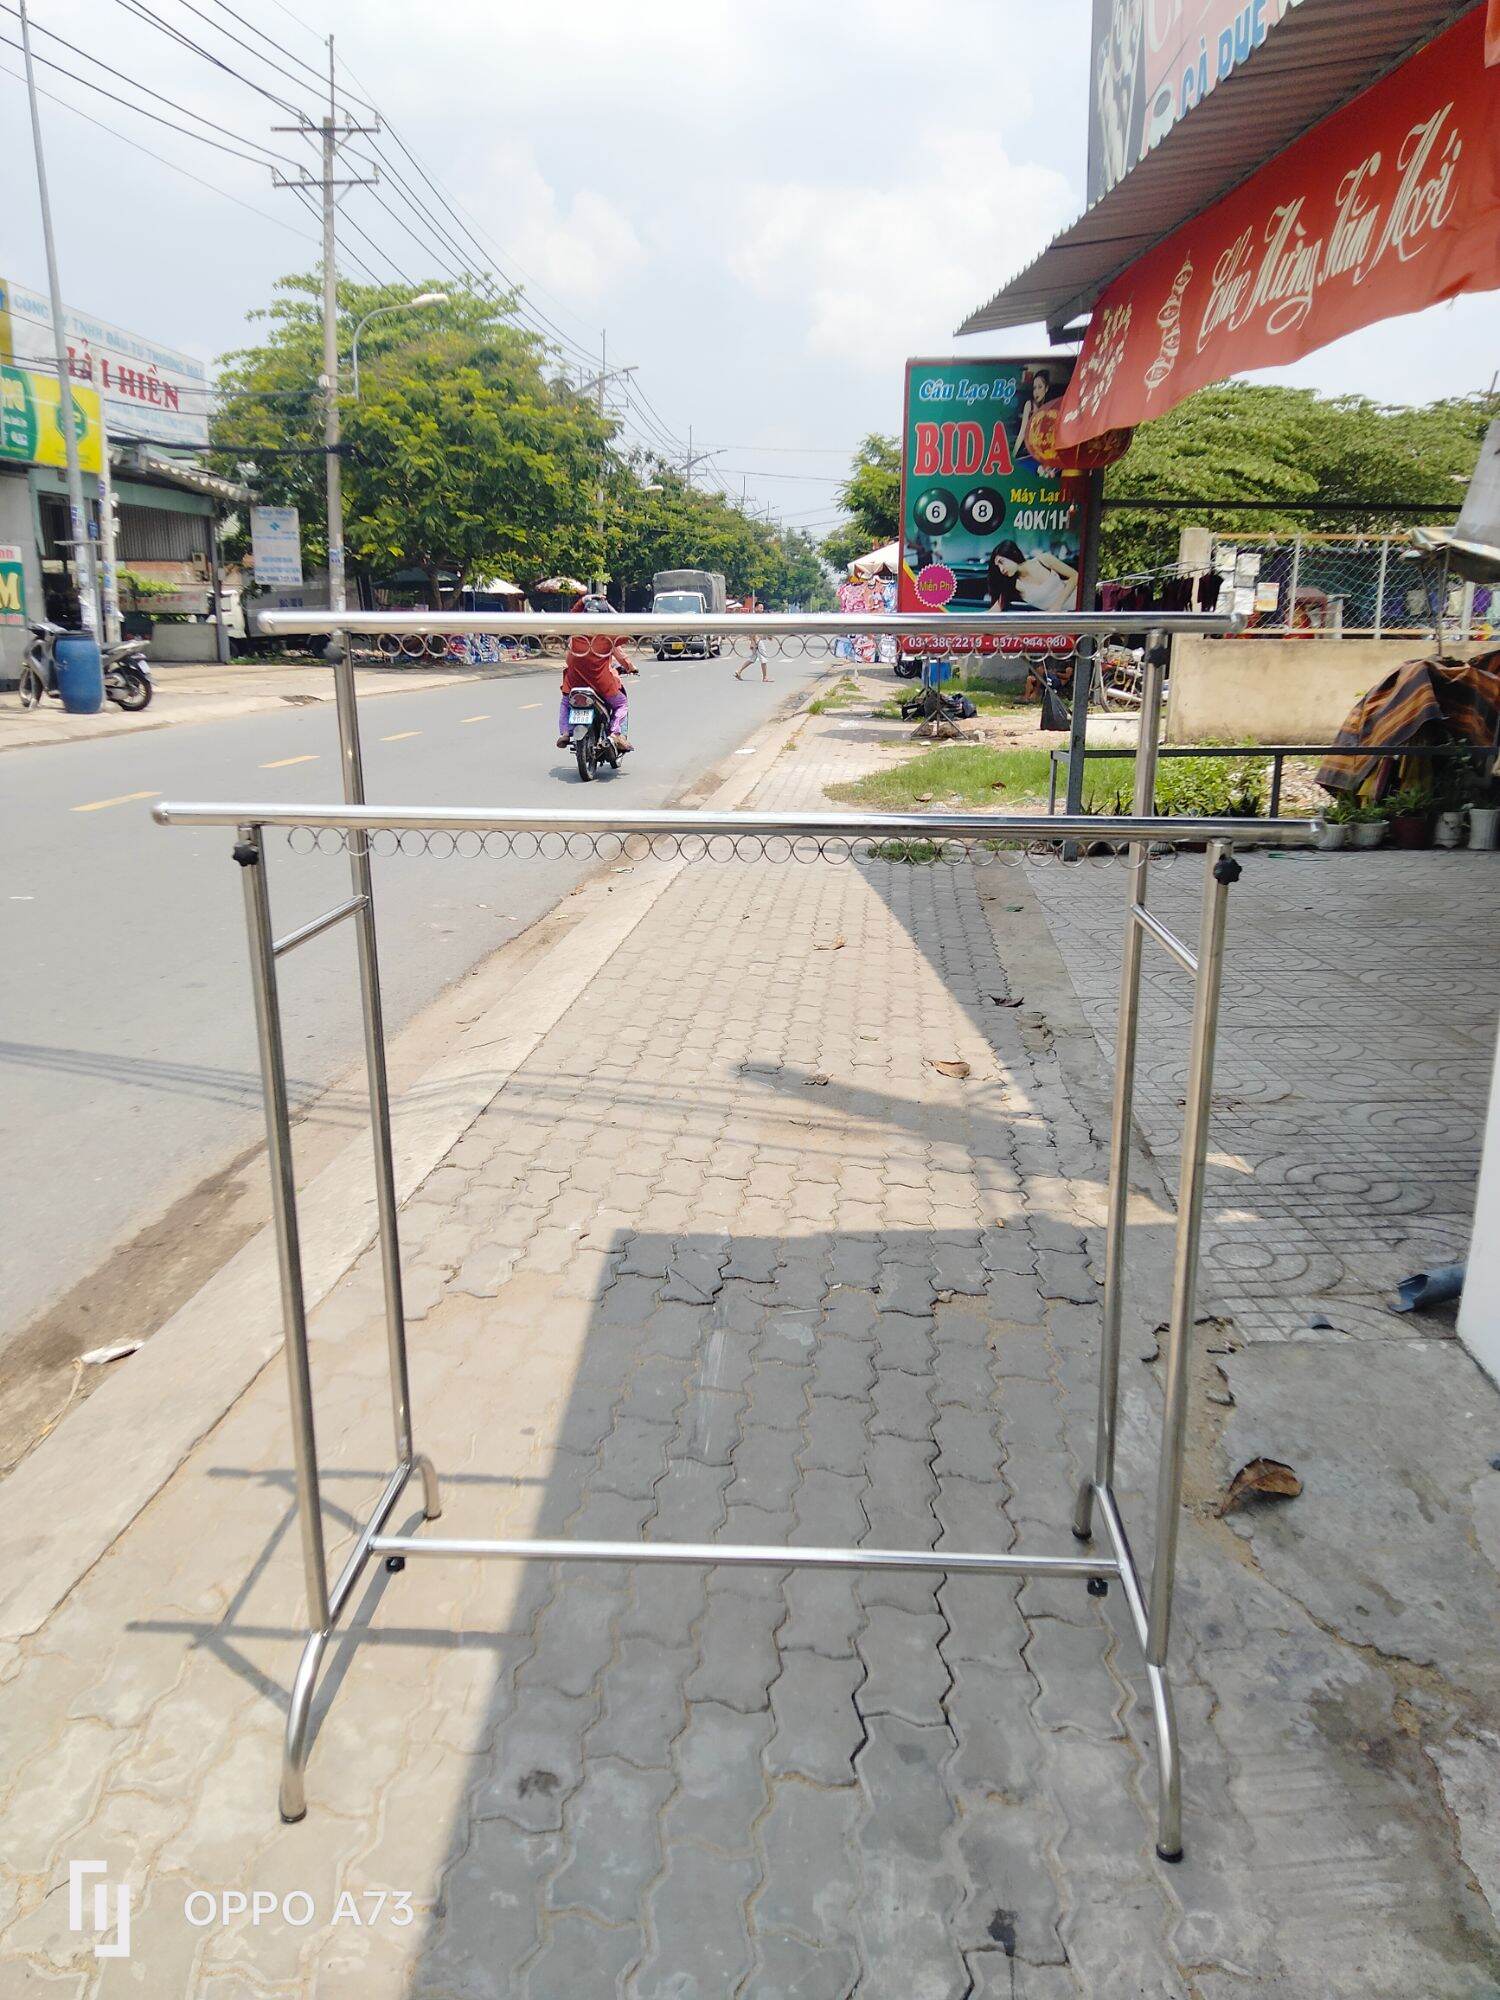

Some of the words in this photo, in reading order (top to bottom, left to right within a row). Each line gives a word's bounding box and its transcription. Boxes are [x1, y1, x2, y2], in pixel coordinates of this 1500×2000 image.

[919, 378, 955, 402] Câu
[956, 378, 990, 406] Lạc
[989, 377, 1017, 405] Bộ
[913, 421, 1015, 476] BIDA
[1010, 488, 1037, 505] Máy
[931, 504, 941, 519] 6
[978, 504, 987, 519] 8
[1013, 509, 1071, 530] 40K/1H
